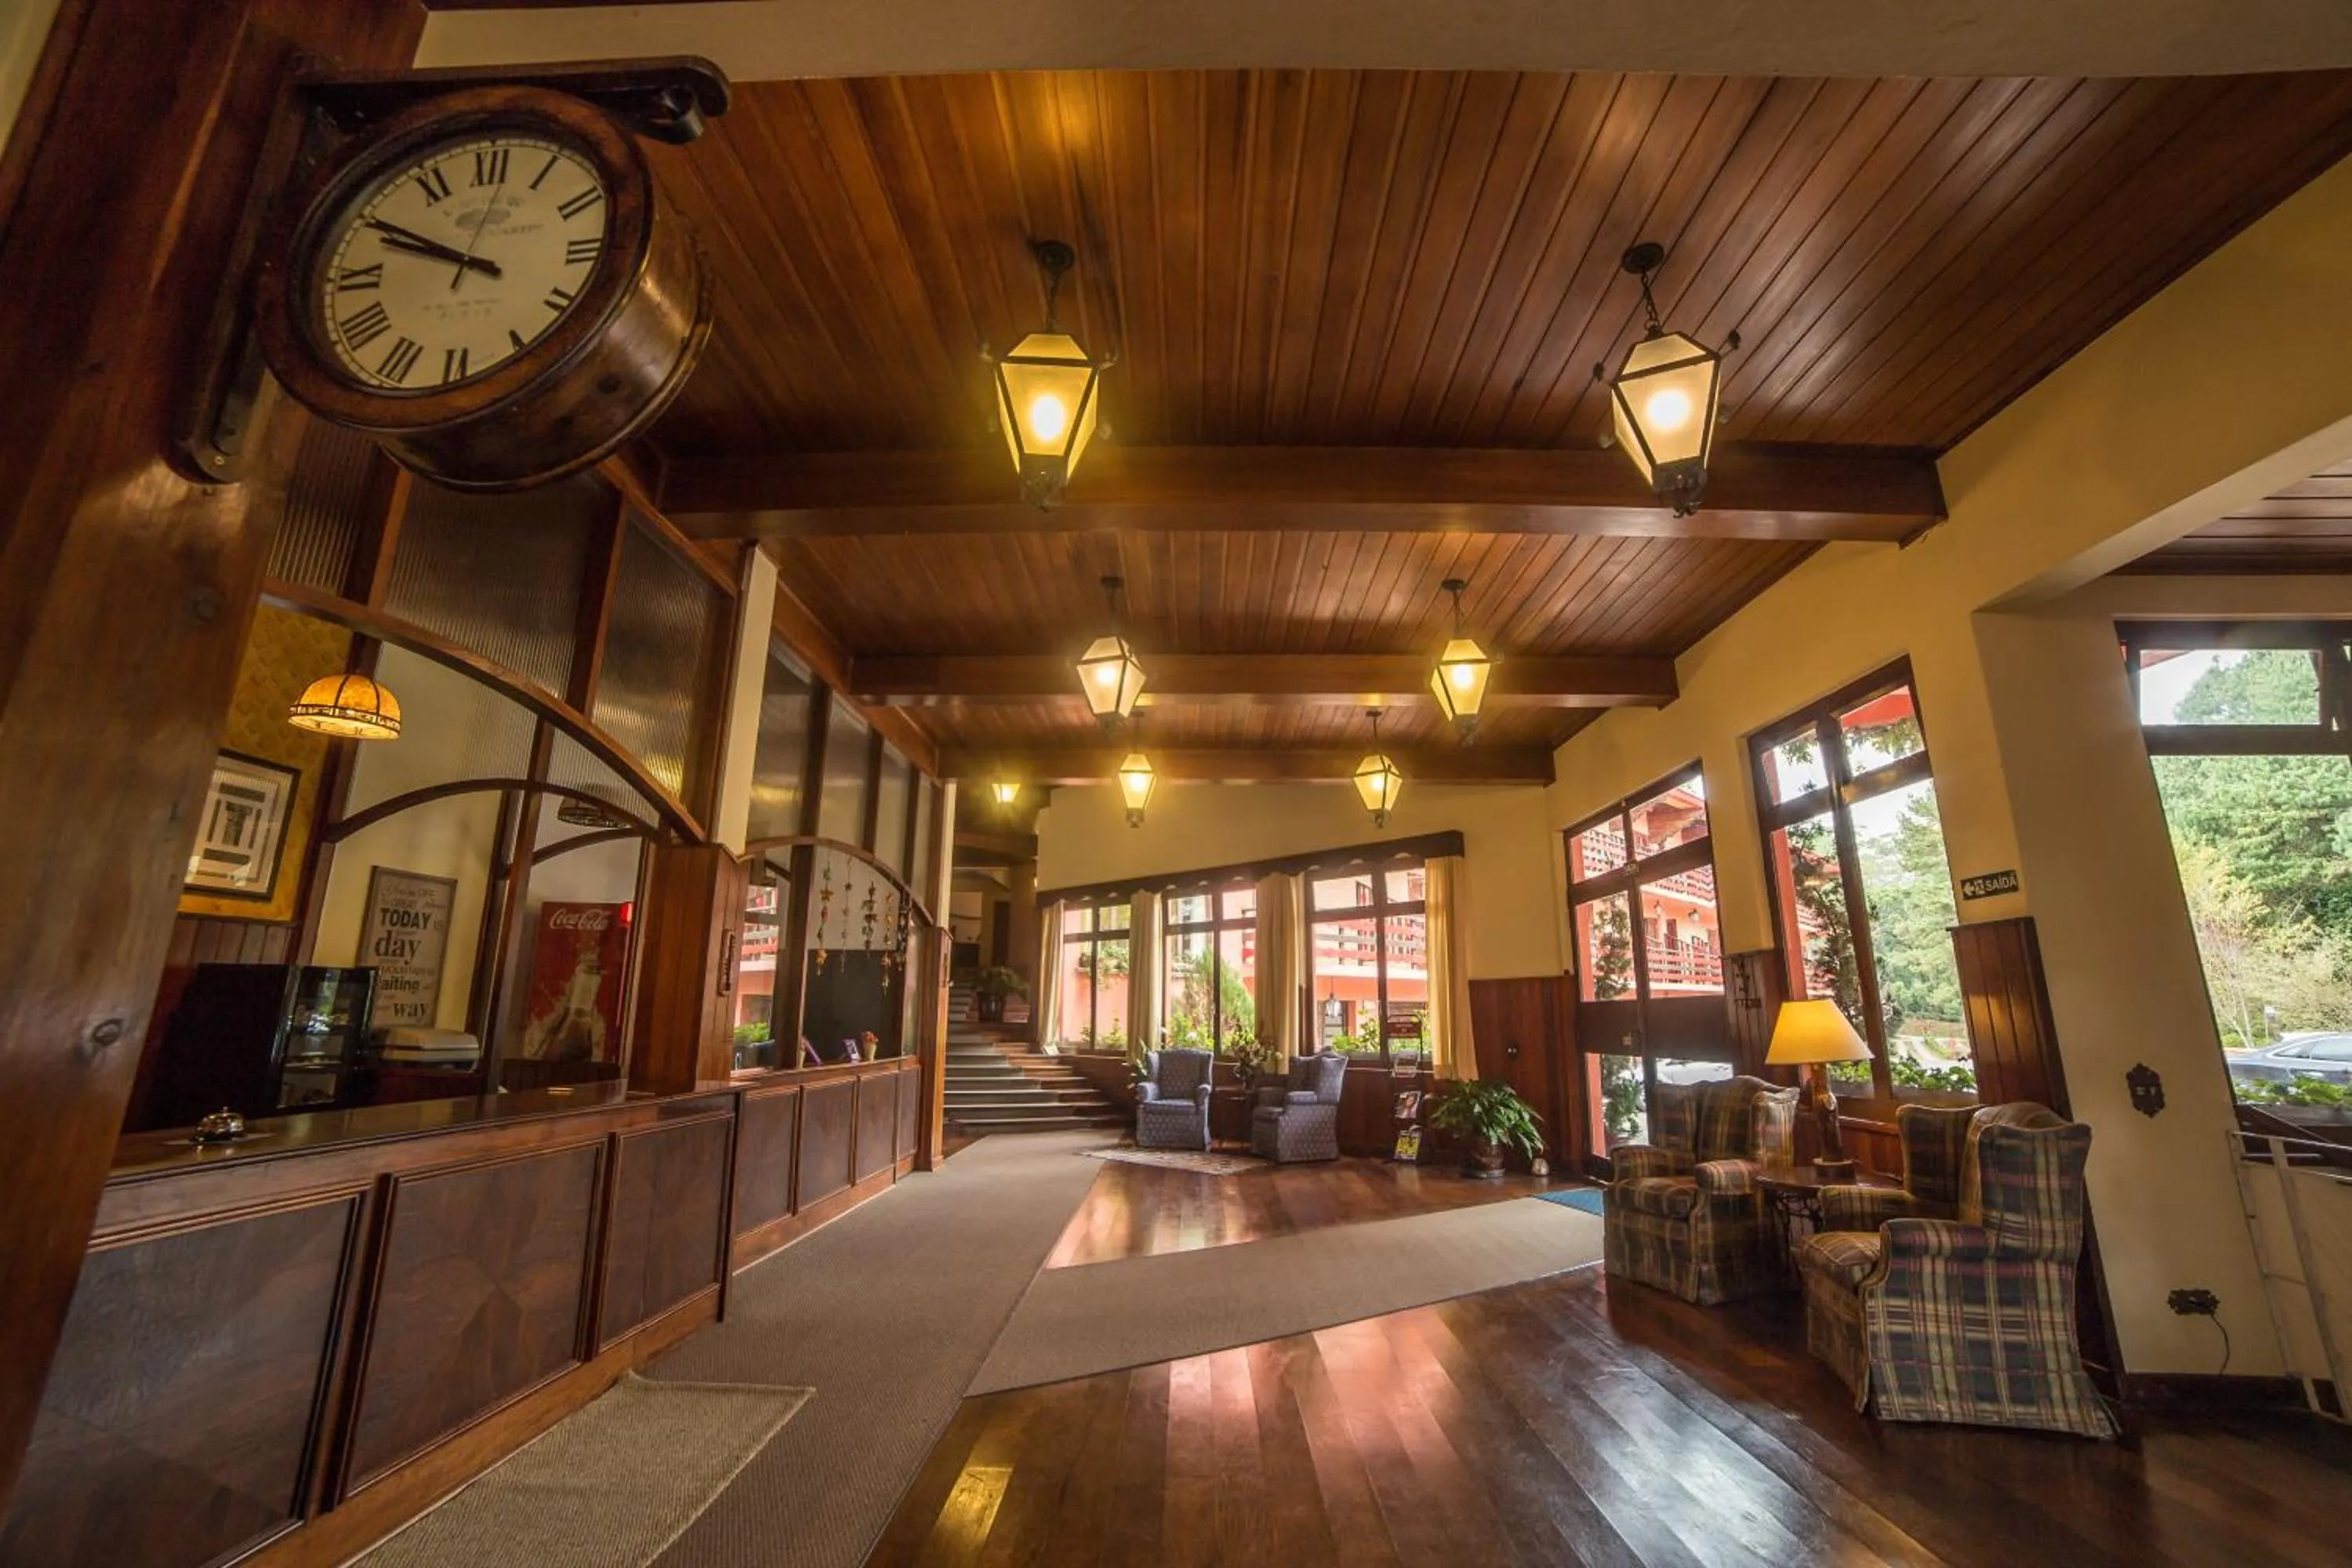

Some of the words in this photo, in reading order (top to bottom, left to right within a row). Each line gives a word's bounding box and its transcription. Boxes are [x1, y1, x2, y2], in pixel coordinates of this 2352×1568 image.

[470, 149, 510, 187] XII
[416, 167, 452, 208] XI
[557, 185, 604, 220] II
[564, 238, 603, 264] III
[380, 907, 431, 930] TODAY
[375, 930, 422, 965] day
[379, 975, 420, 994] aiting
[394, 1003, 428, 1023] way
